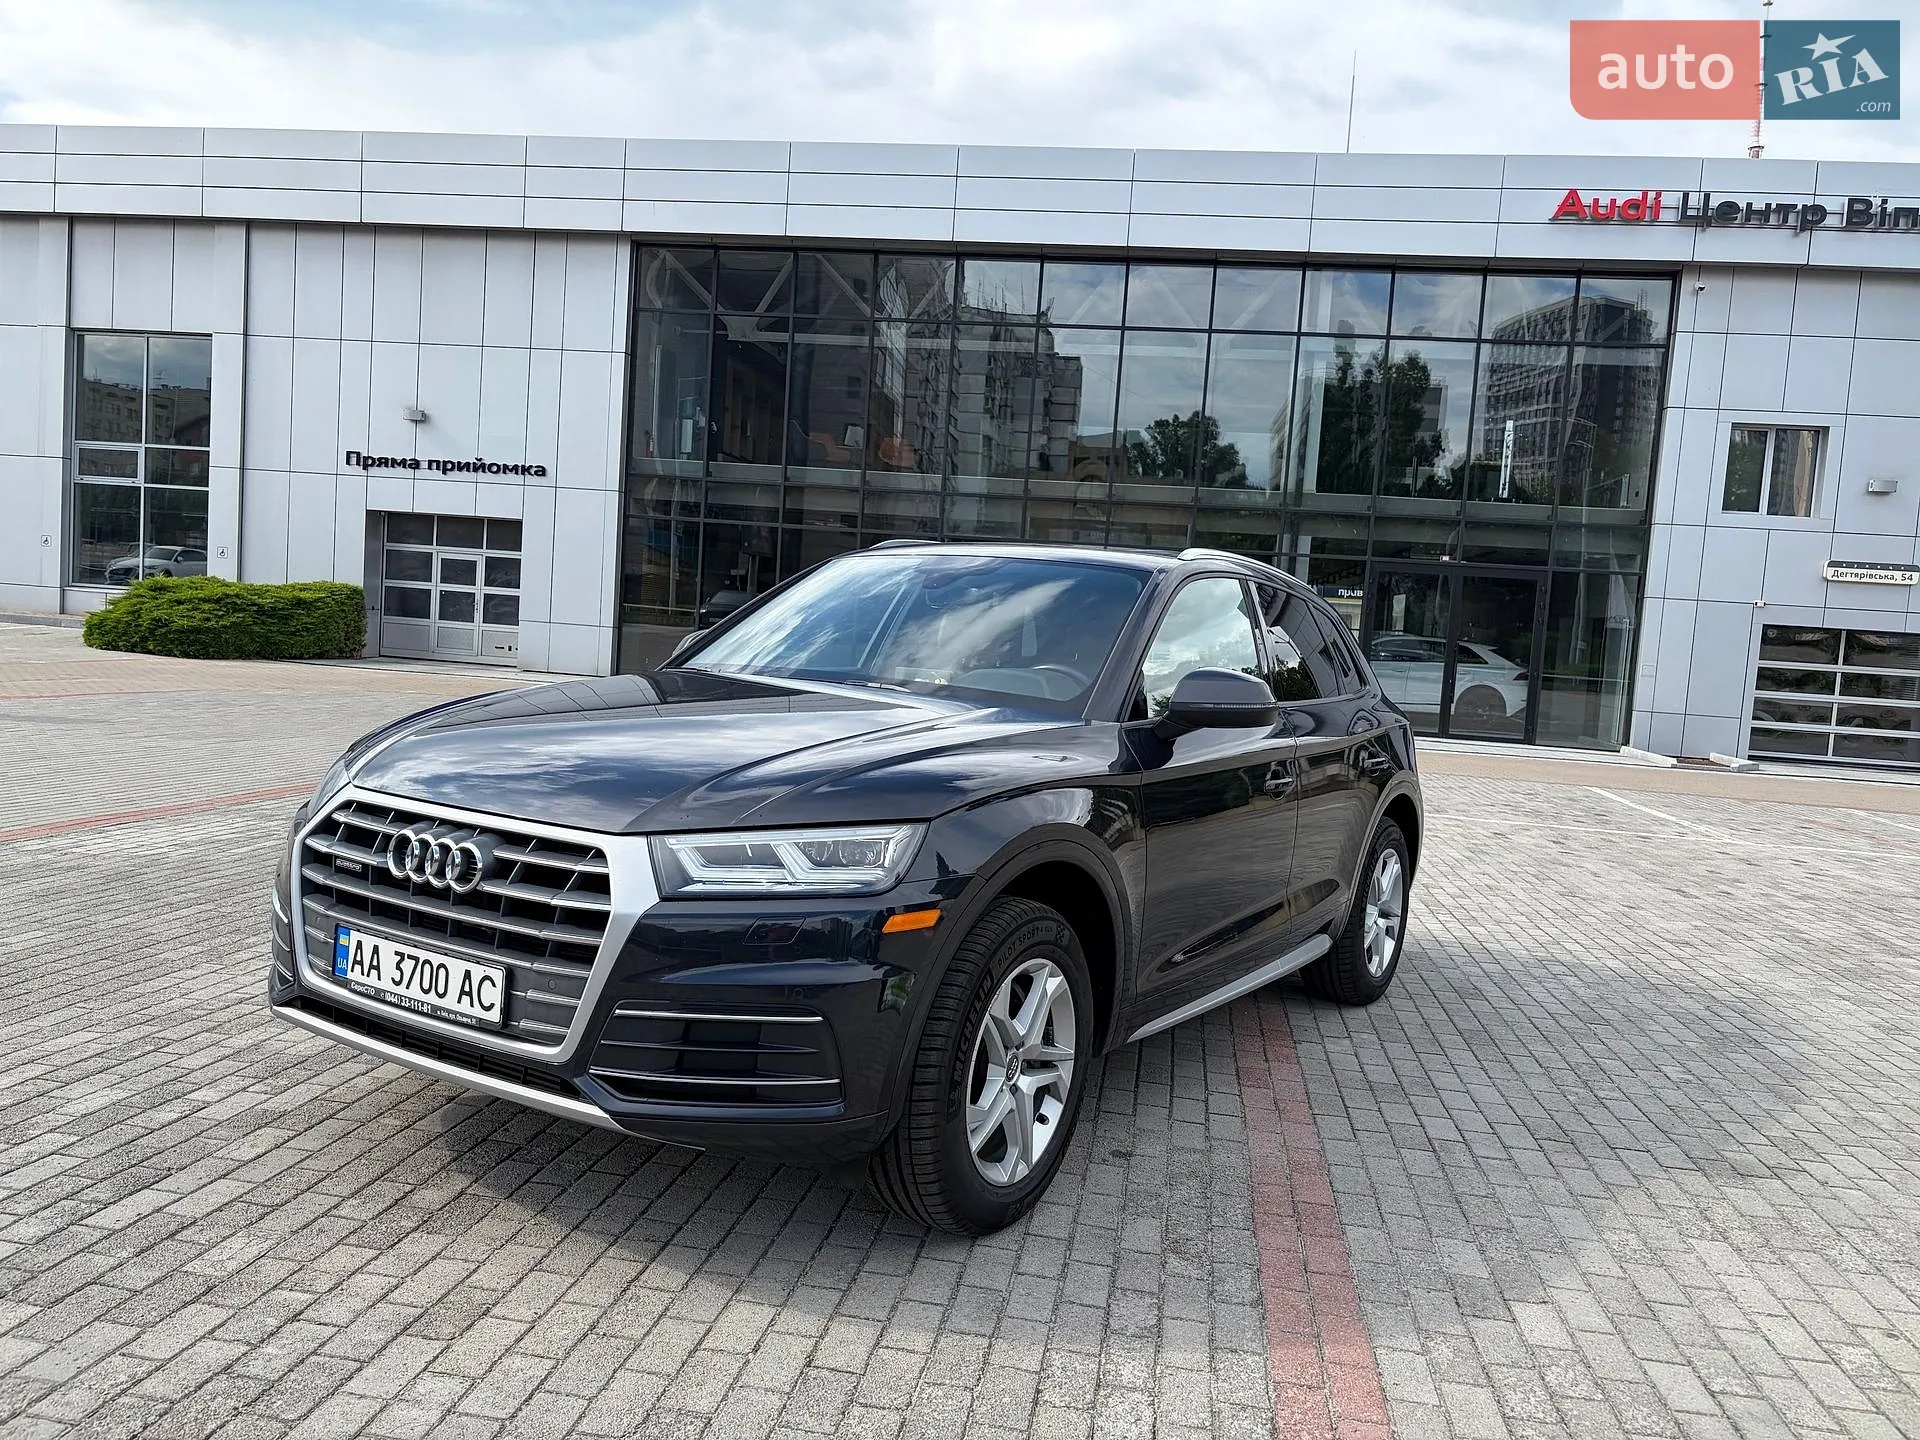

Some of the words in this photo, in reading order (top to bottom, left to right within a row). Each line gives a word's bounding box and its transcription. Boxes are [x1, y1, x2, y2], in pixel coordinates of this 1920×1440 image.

[1551, 188, 1662, 221] Audi
[1678, 191, 1828, 235] Центр
[345, 450, 421, 470] Пряма
[427, 457, 547, 477] прийомка
[1831, 569, 1898, 582] Дегтярівська,
[1900, 573, 1914, 582] 54
[337, 957, 347, 970] UA
[350, 939, 382, 981] AA
[391, 950, 449, 999] 3700
[457, 969, 497, 1012] AC
[954, 969, 994, 1080] MICHELIN
